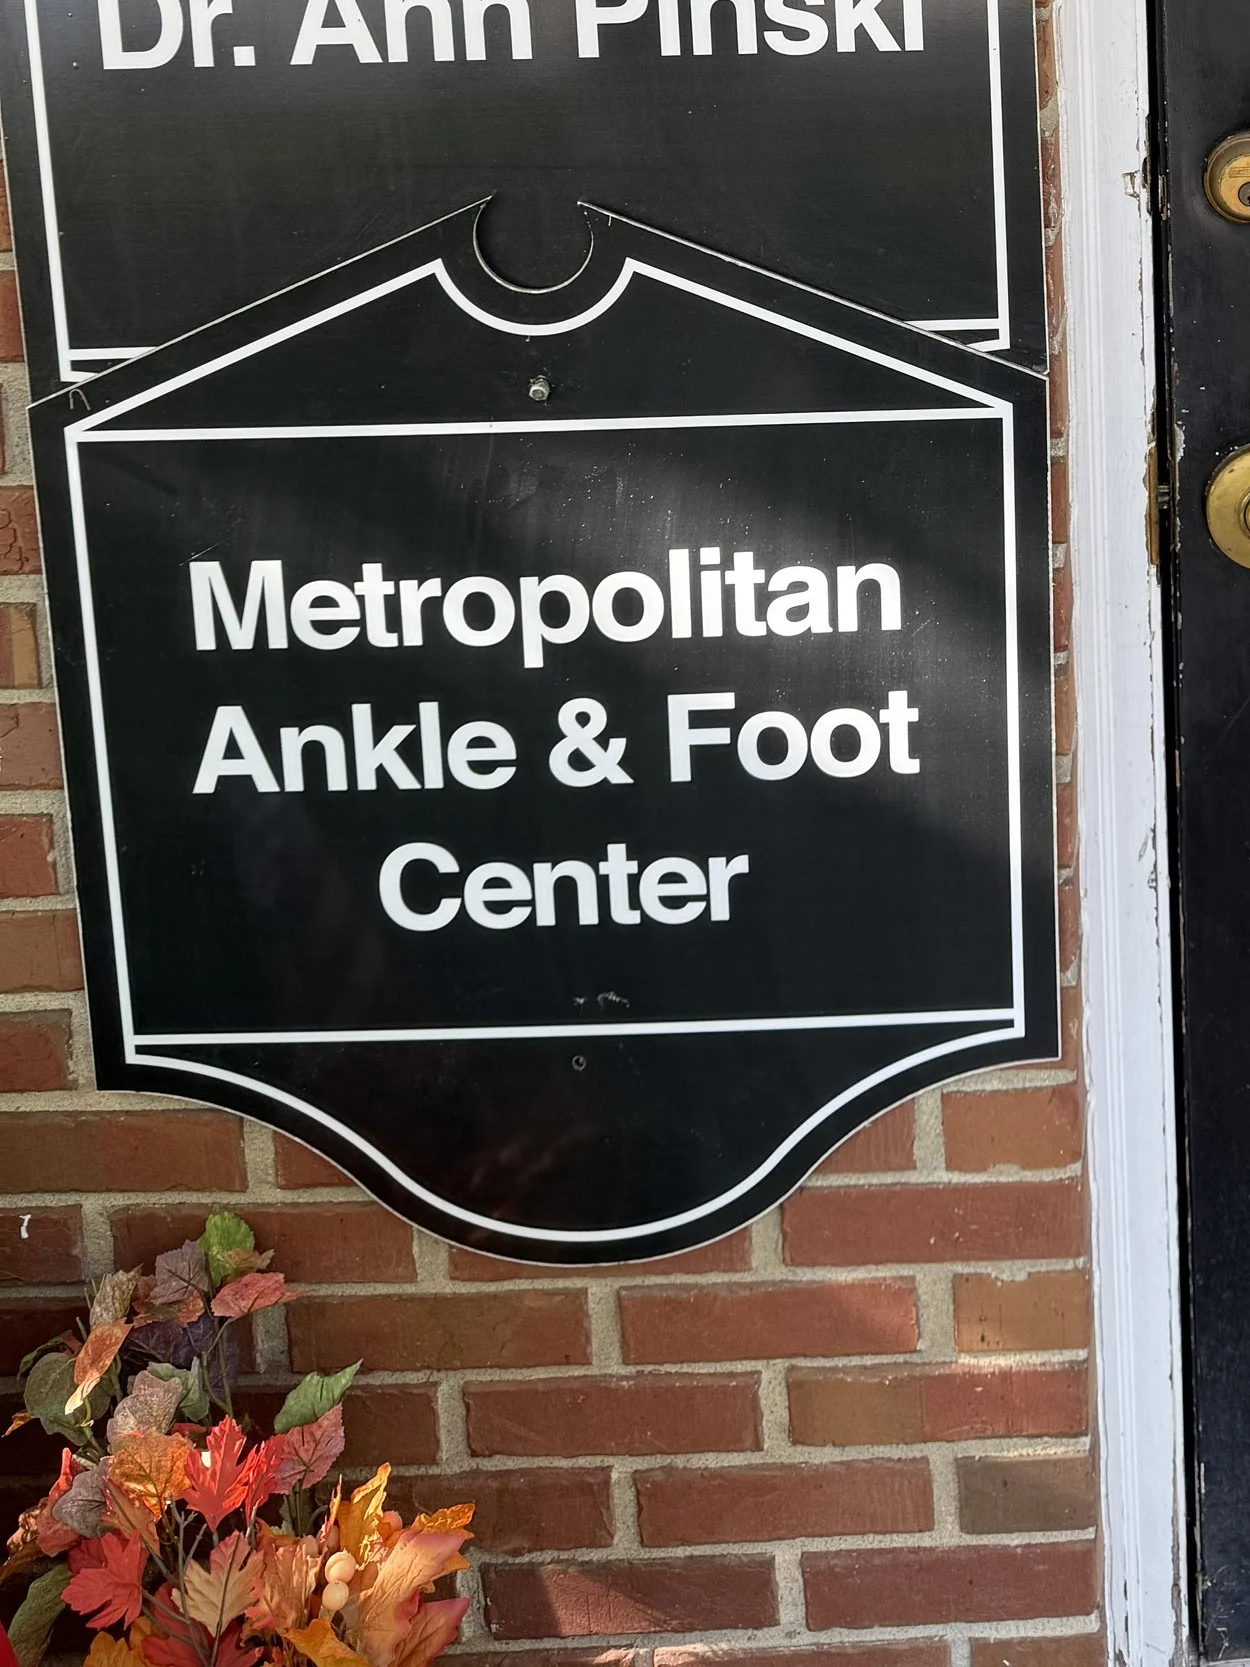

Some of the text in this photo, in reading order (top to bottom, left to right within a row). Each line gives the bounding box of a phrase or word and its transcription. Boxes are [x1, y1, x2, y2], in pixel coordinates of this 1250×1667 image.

[188, 546, 902, 669] Metropolitan
[193, 690, 921, 794] Ankle & Foot
[378, 841, 750, 932] Center
